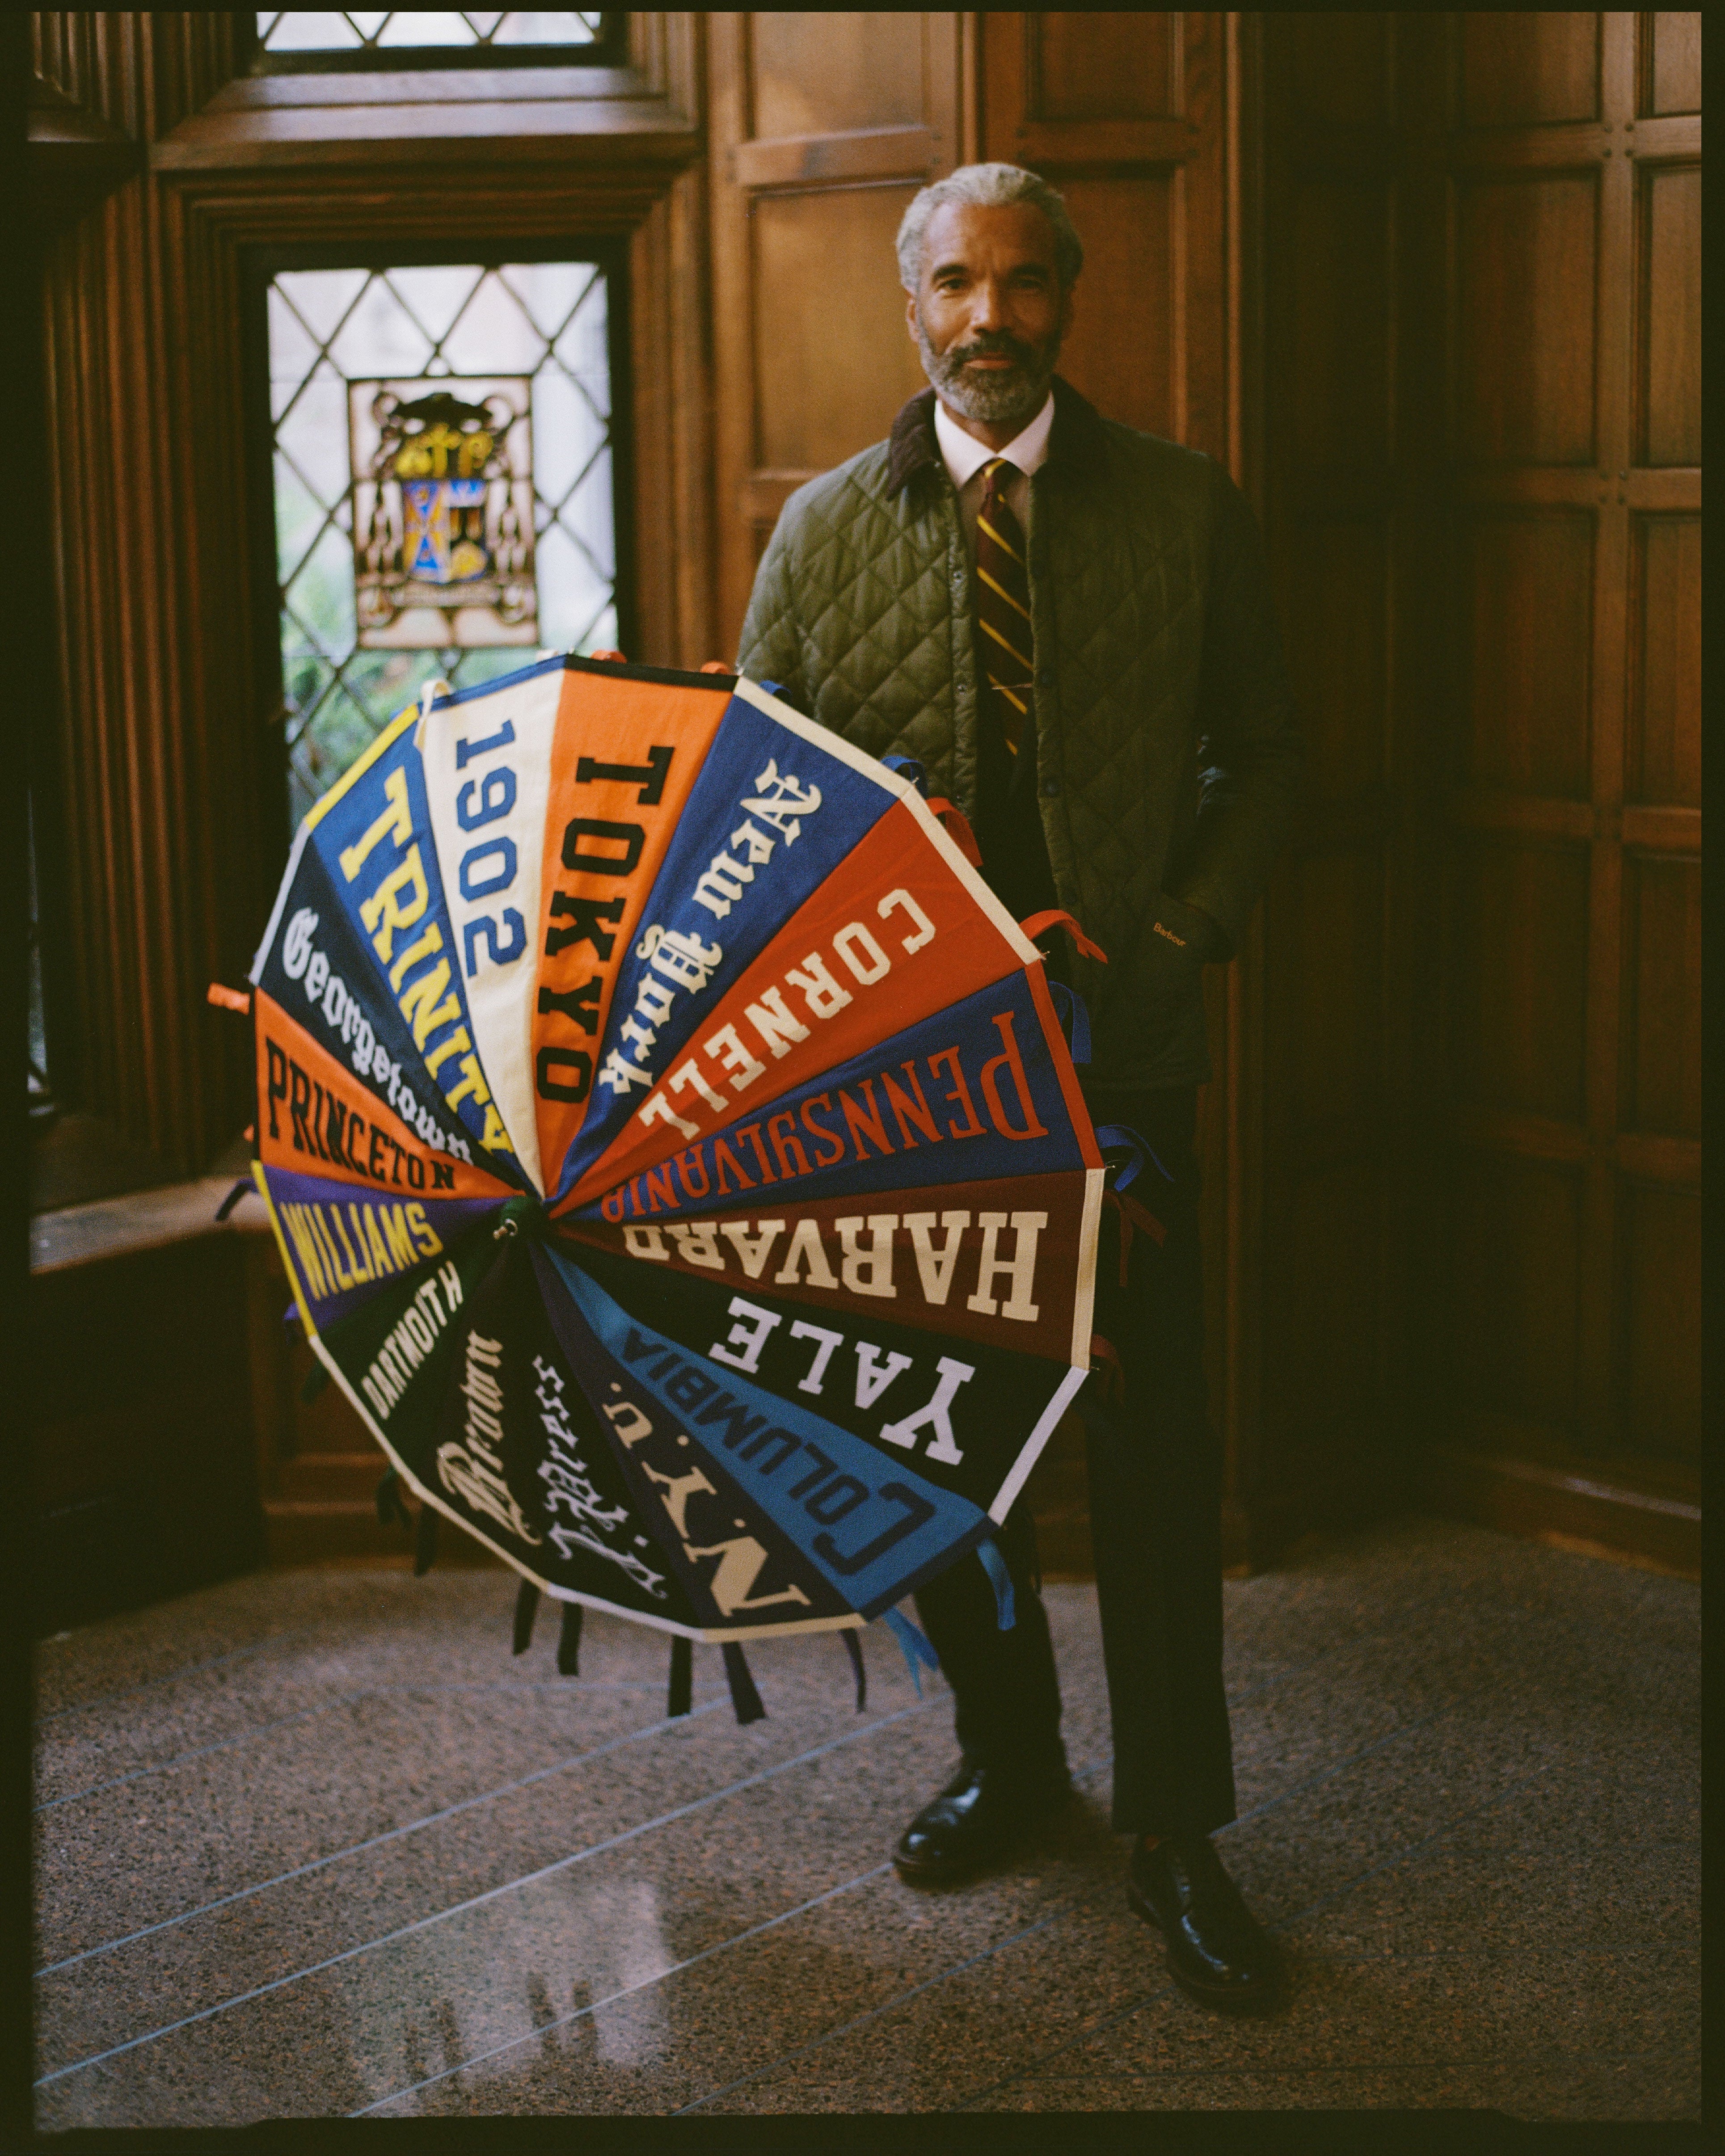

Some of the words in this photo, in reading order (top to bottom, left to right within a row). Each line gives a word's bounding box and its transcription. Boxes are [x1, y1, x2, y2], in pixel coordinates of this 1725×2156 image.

[456, 720, 526, 978] 1902
[537, 746, 675, 1104] TOKYO
[693, 758, 822, 919] New
[339, 766, 514, 1158] TRINITY
[599, 924, 723, 1094] York
[637, 889, 936, 1141] CORNELL
[1153, 922, 1186, 947] Barbour
[265, 1036, 455, 1190] PRINCETON
[283, 908, 473, 1166] Georgetown
[600, 1011, 1049, 1223] PENNSYLVANIA
[280, 1202, 444, 1301] WILLIAMS
[623, 1210, 1048, 1322] HARVARD
[437, 1329, 542, 1545] Brown
[531, 1354, 629, 1525] Press
[623, 1327, 936, 1577] COLUMBIA
[709, 1297, 976, 1466] YALE
